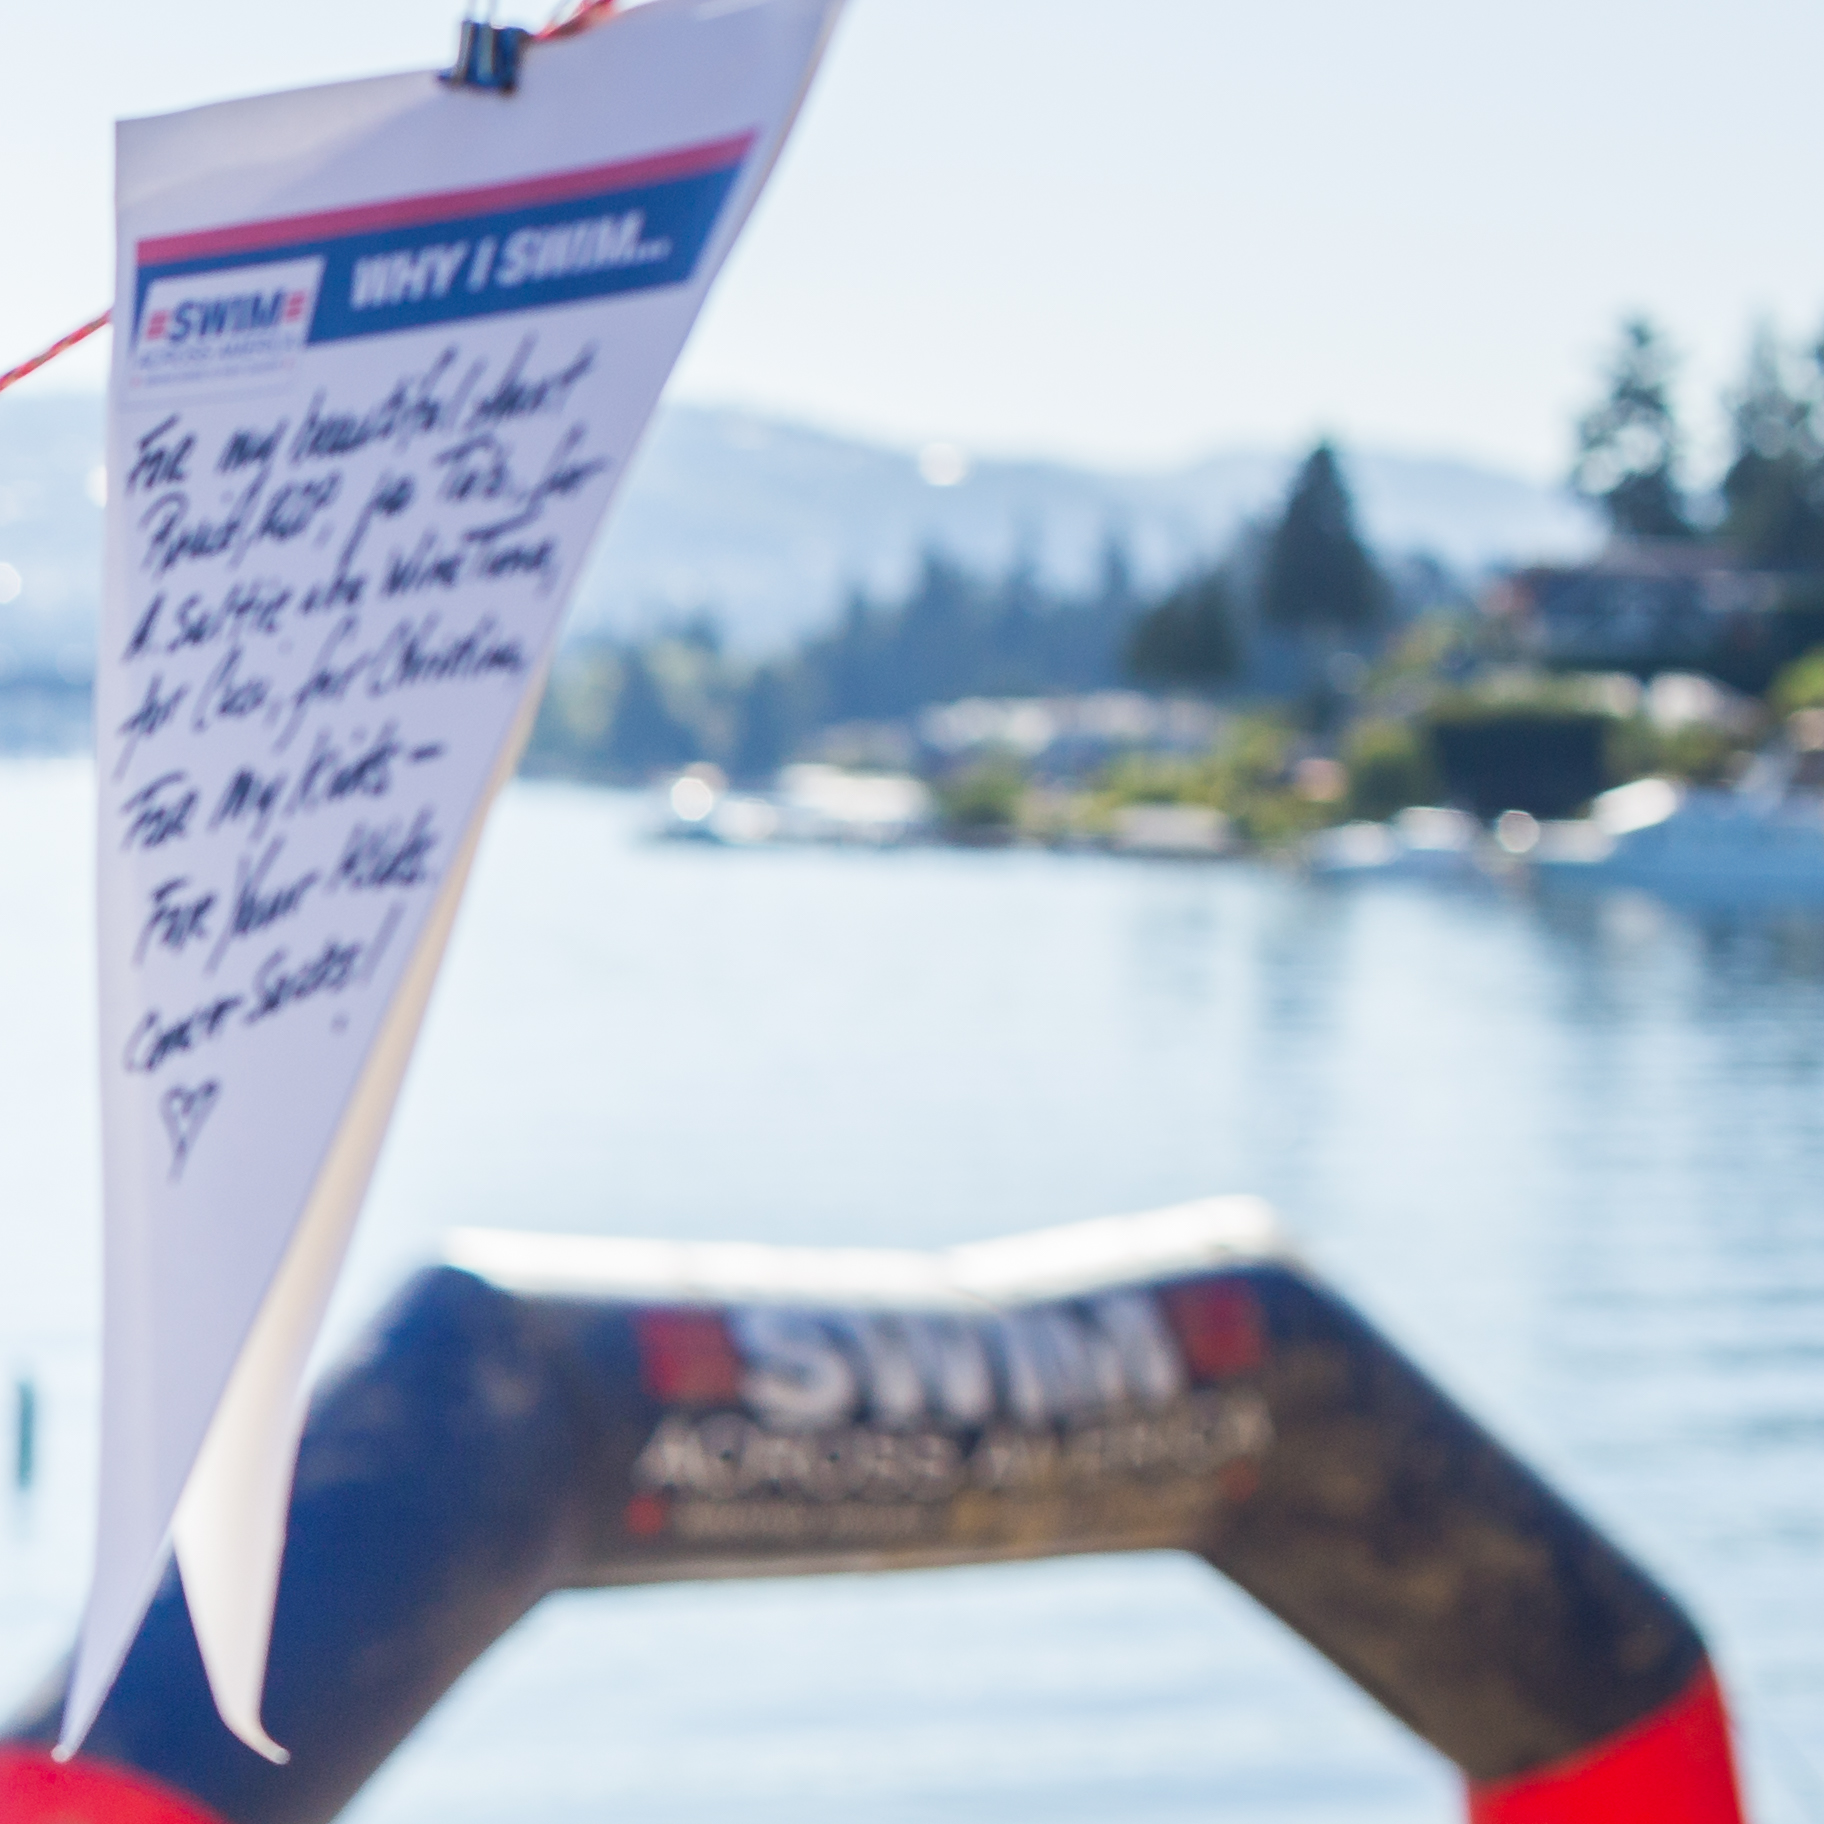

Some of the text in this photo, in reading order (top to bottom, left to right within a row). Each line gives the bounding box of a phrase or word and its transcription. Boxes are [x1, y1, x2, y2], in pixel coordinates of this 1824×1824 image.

[353, 210, 671, 311] WHY I SWIM...
[169, 288, 286, 343] SWIM
